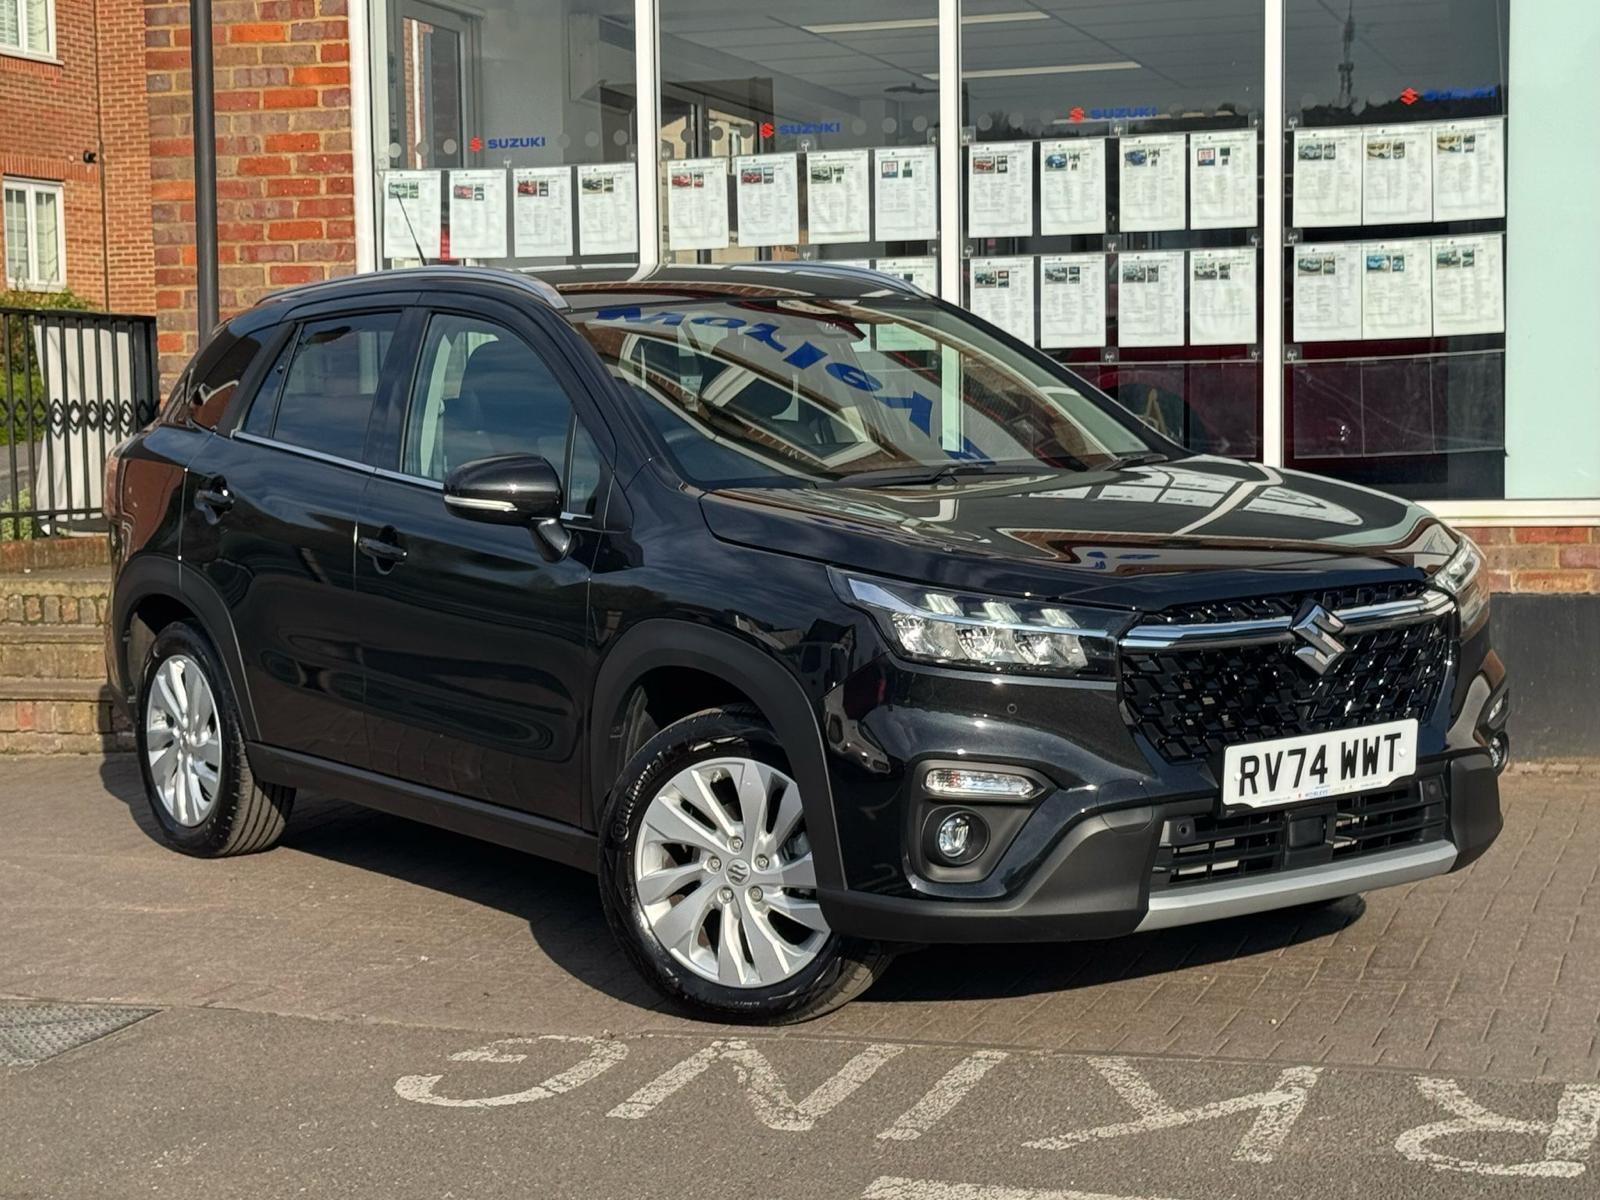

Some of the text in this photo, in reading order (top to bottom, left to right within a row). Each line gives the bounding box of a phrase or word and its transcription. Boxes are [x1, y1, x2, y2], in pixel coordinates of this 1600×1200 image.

[779, 121, 841, 136] SUZUKI
[487, 136, 547, 150] SUZUKI
[1238, 732, 1402, 797] RV74 WWT
